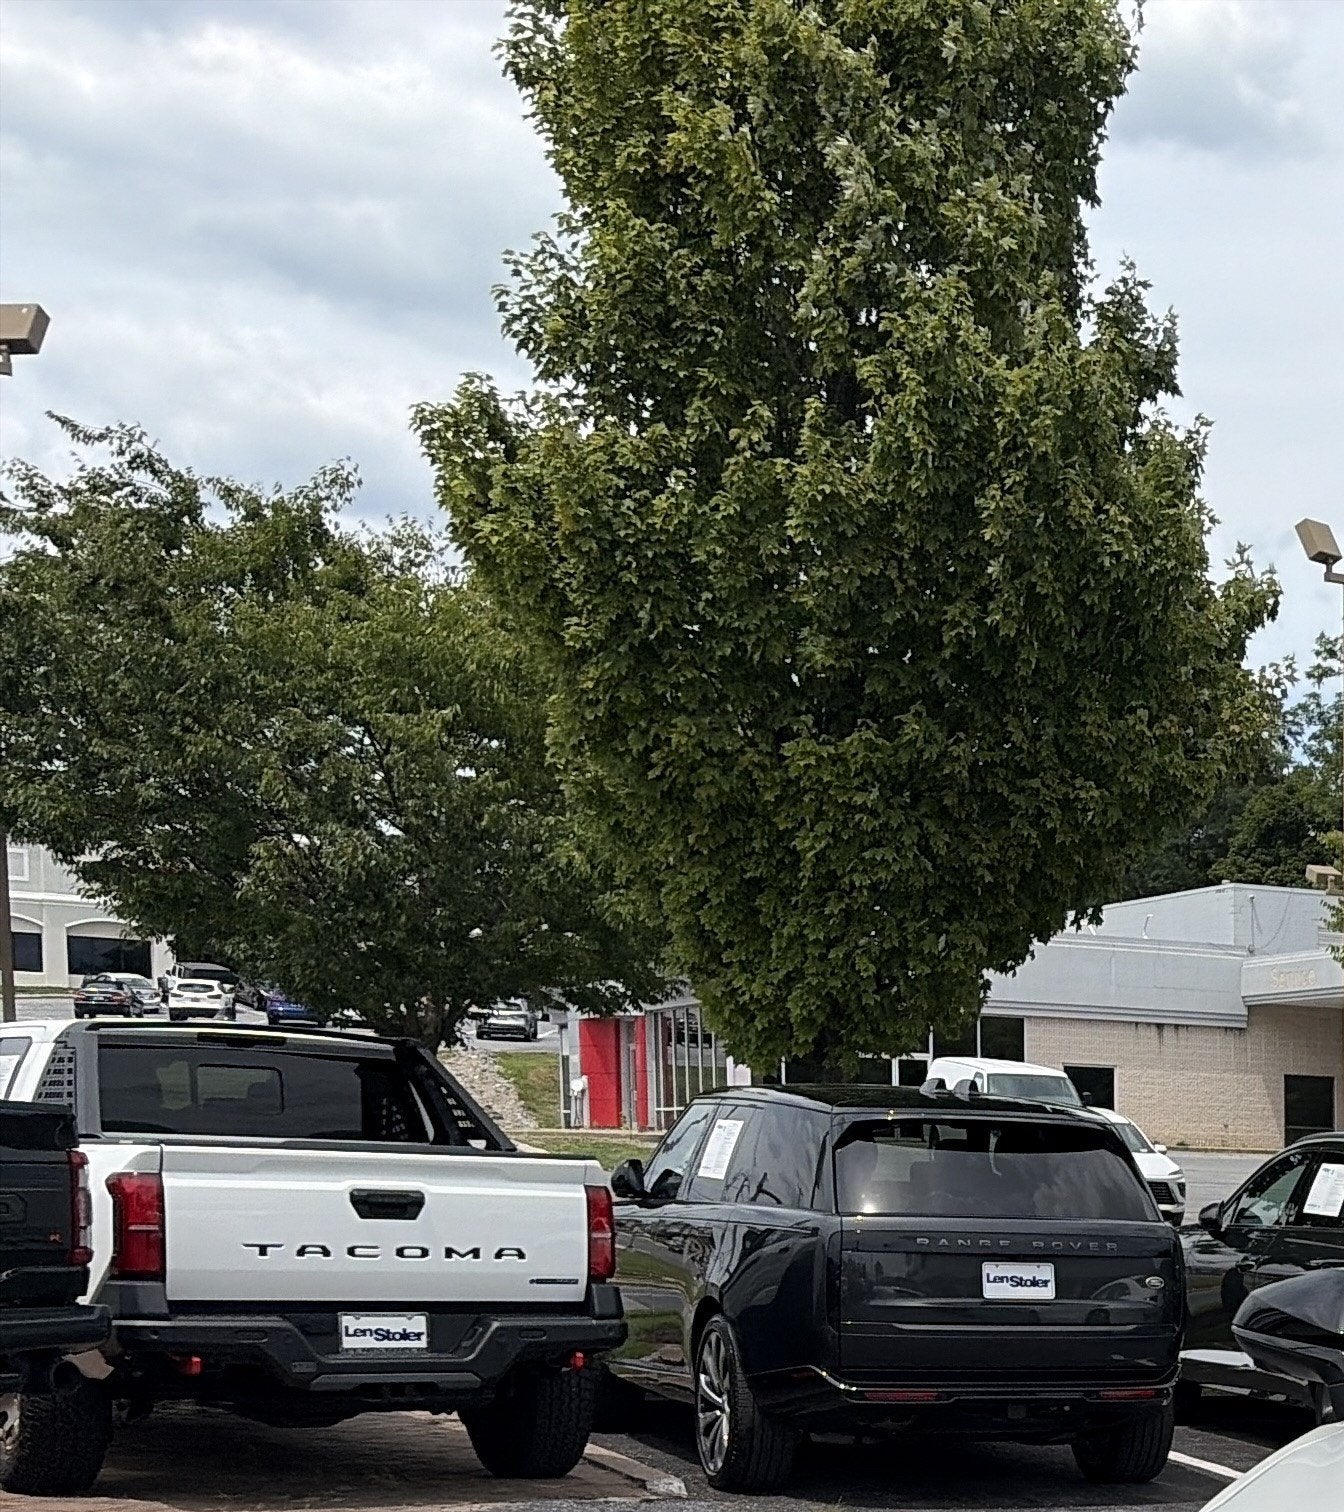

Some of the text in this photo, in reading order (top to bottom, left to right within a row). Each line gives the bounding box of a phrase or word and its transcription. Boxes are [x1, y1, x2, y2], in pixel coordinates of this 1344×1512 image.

[242, 1242, 527, 1261] TACOMA
[916, 1237, 1118, 1251] RANGE ROVER
